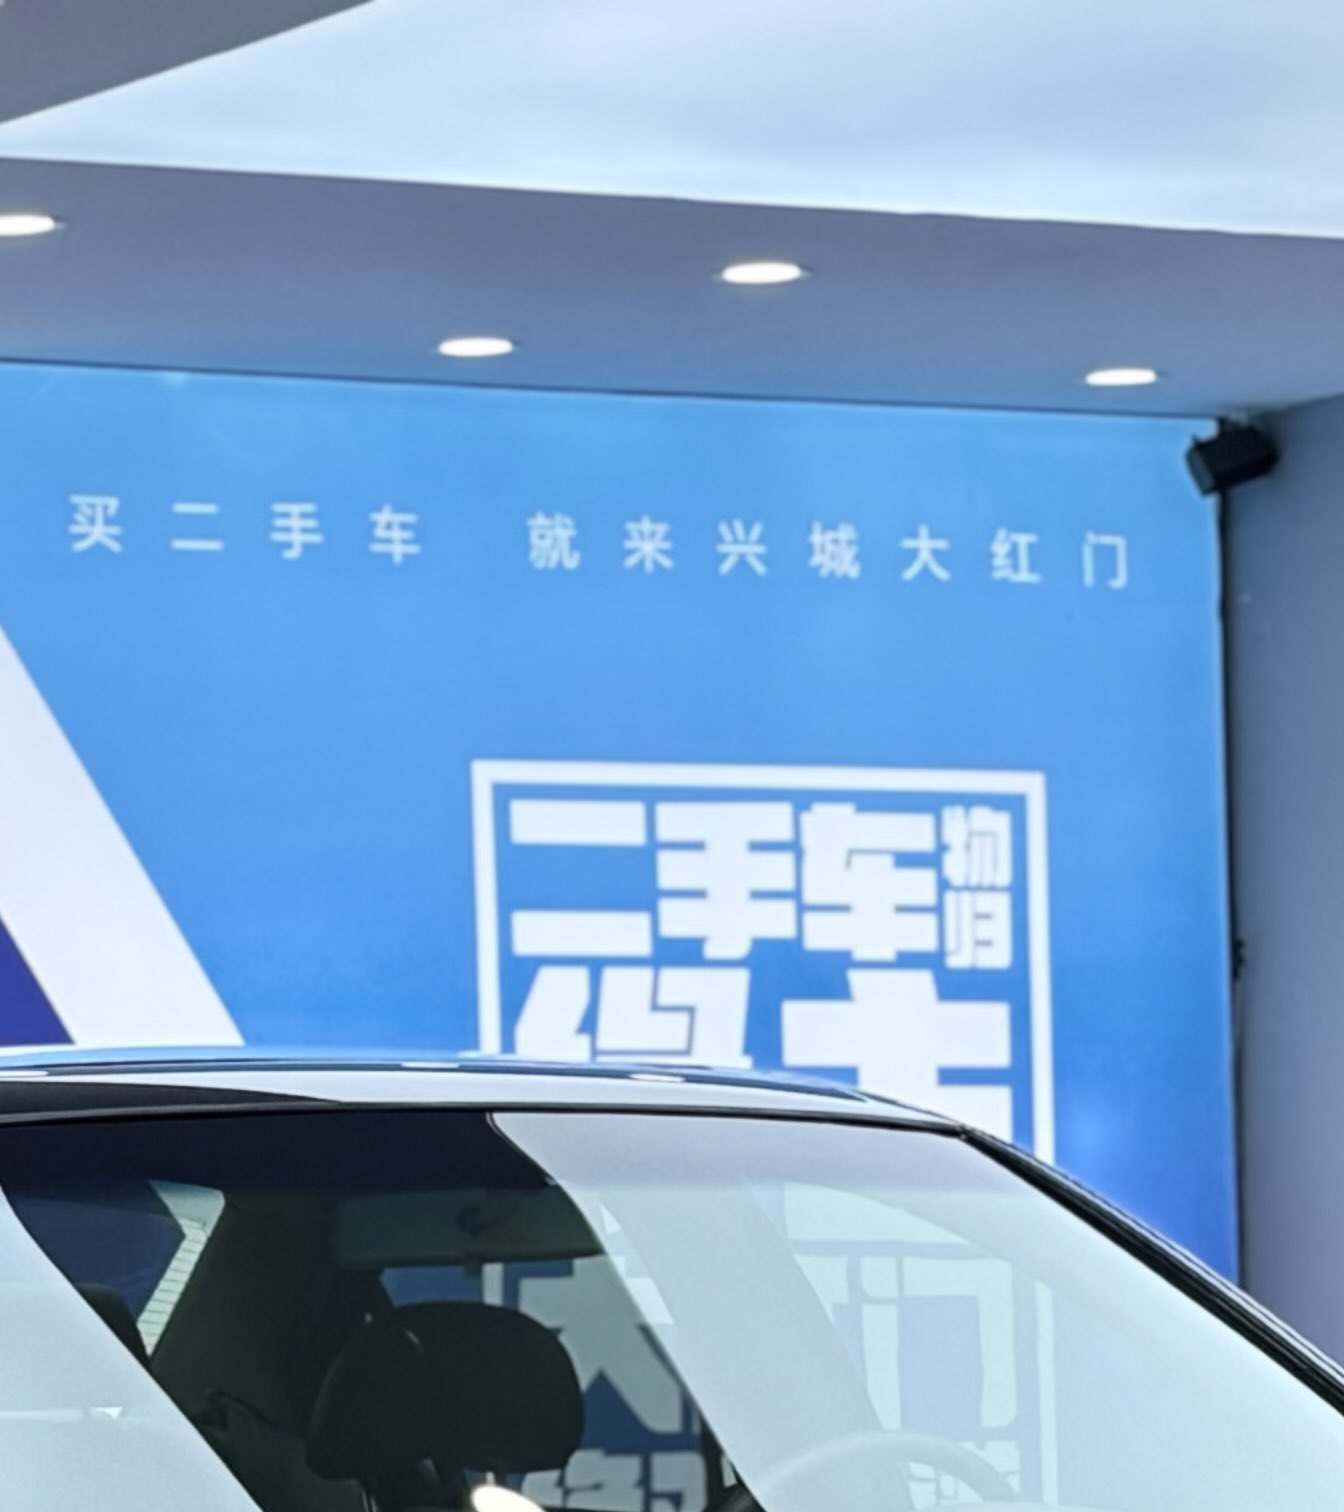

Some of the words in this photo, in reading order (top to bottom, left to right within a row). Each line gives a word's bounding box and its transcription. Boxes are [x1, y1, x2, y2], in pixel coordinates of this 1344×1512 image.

[67, 494, 423, 564] 买二手车
[526, 511, 1132, 589] 就来兴城大红门
